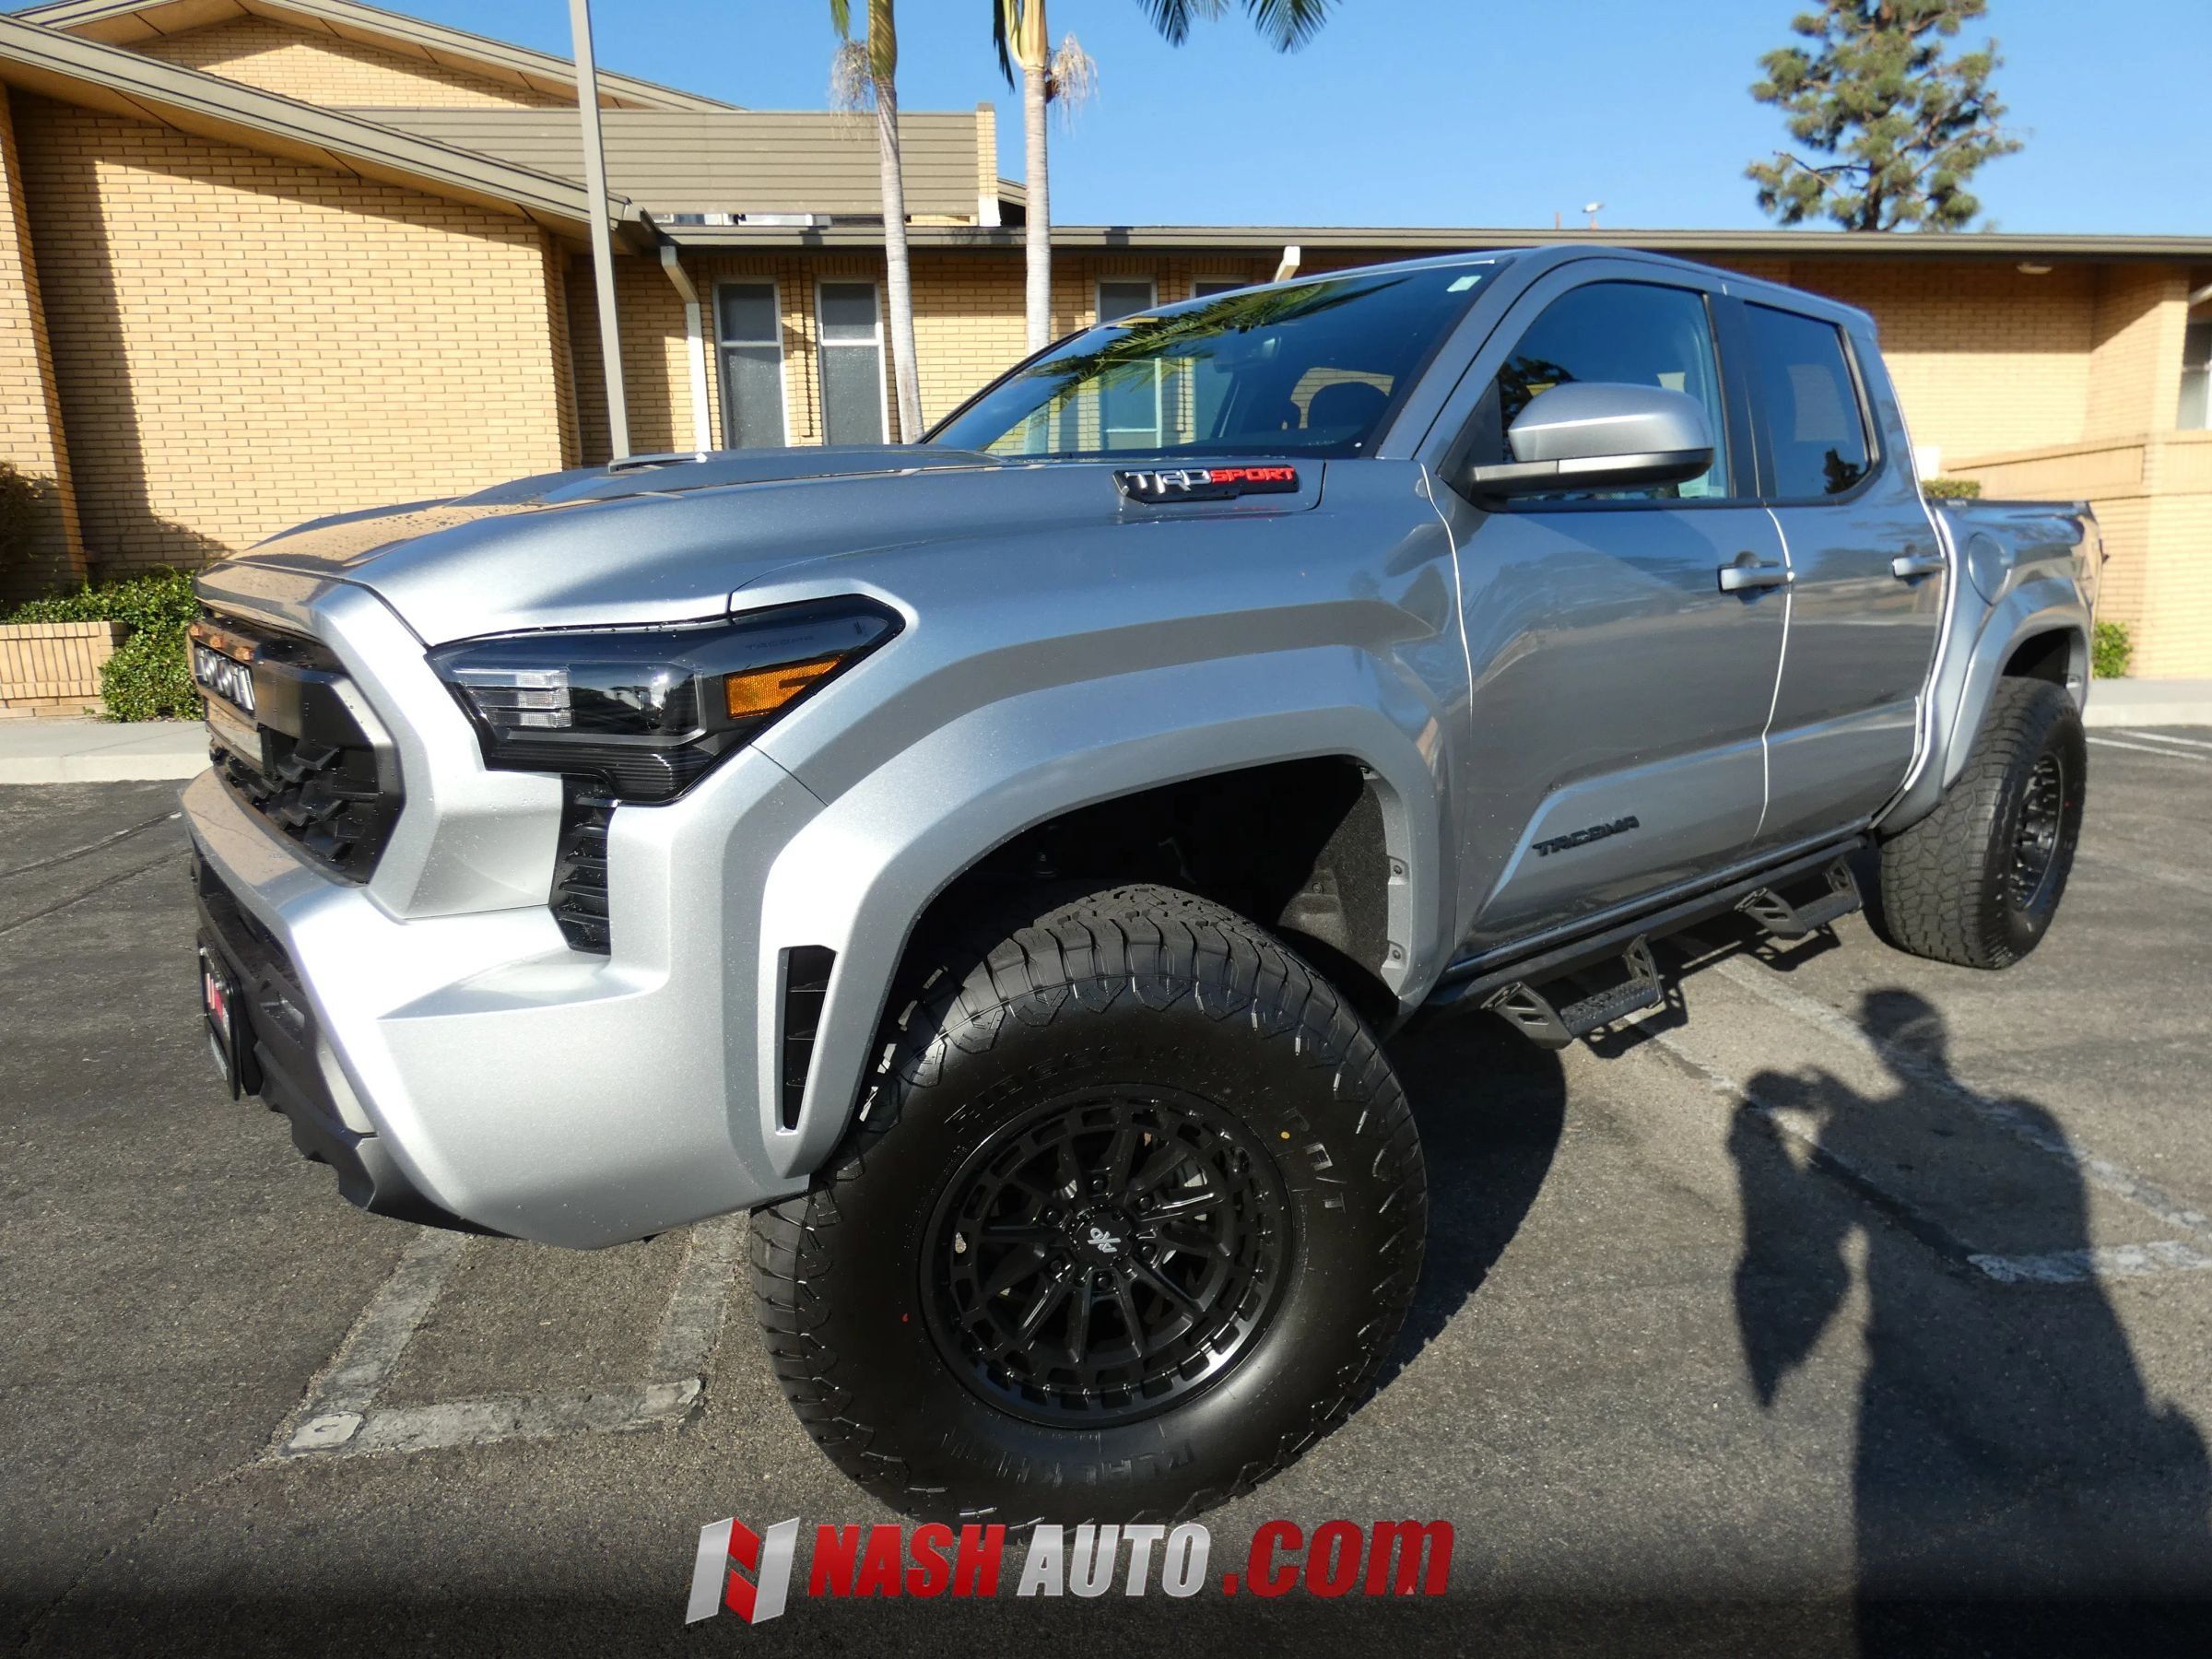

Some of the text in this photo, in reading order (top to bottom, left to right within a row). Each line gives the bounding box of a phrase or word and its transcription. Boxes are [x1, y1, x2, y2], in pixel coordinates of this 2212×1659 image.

[1125, 466, 1294, 494] TRD SPORT
[1532, 816, 1640, 856] TACOMA
